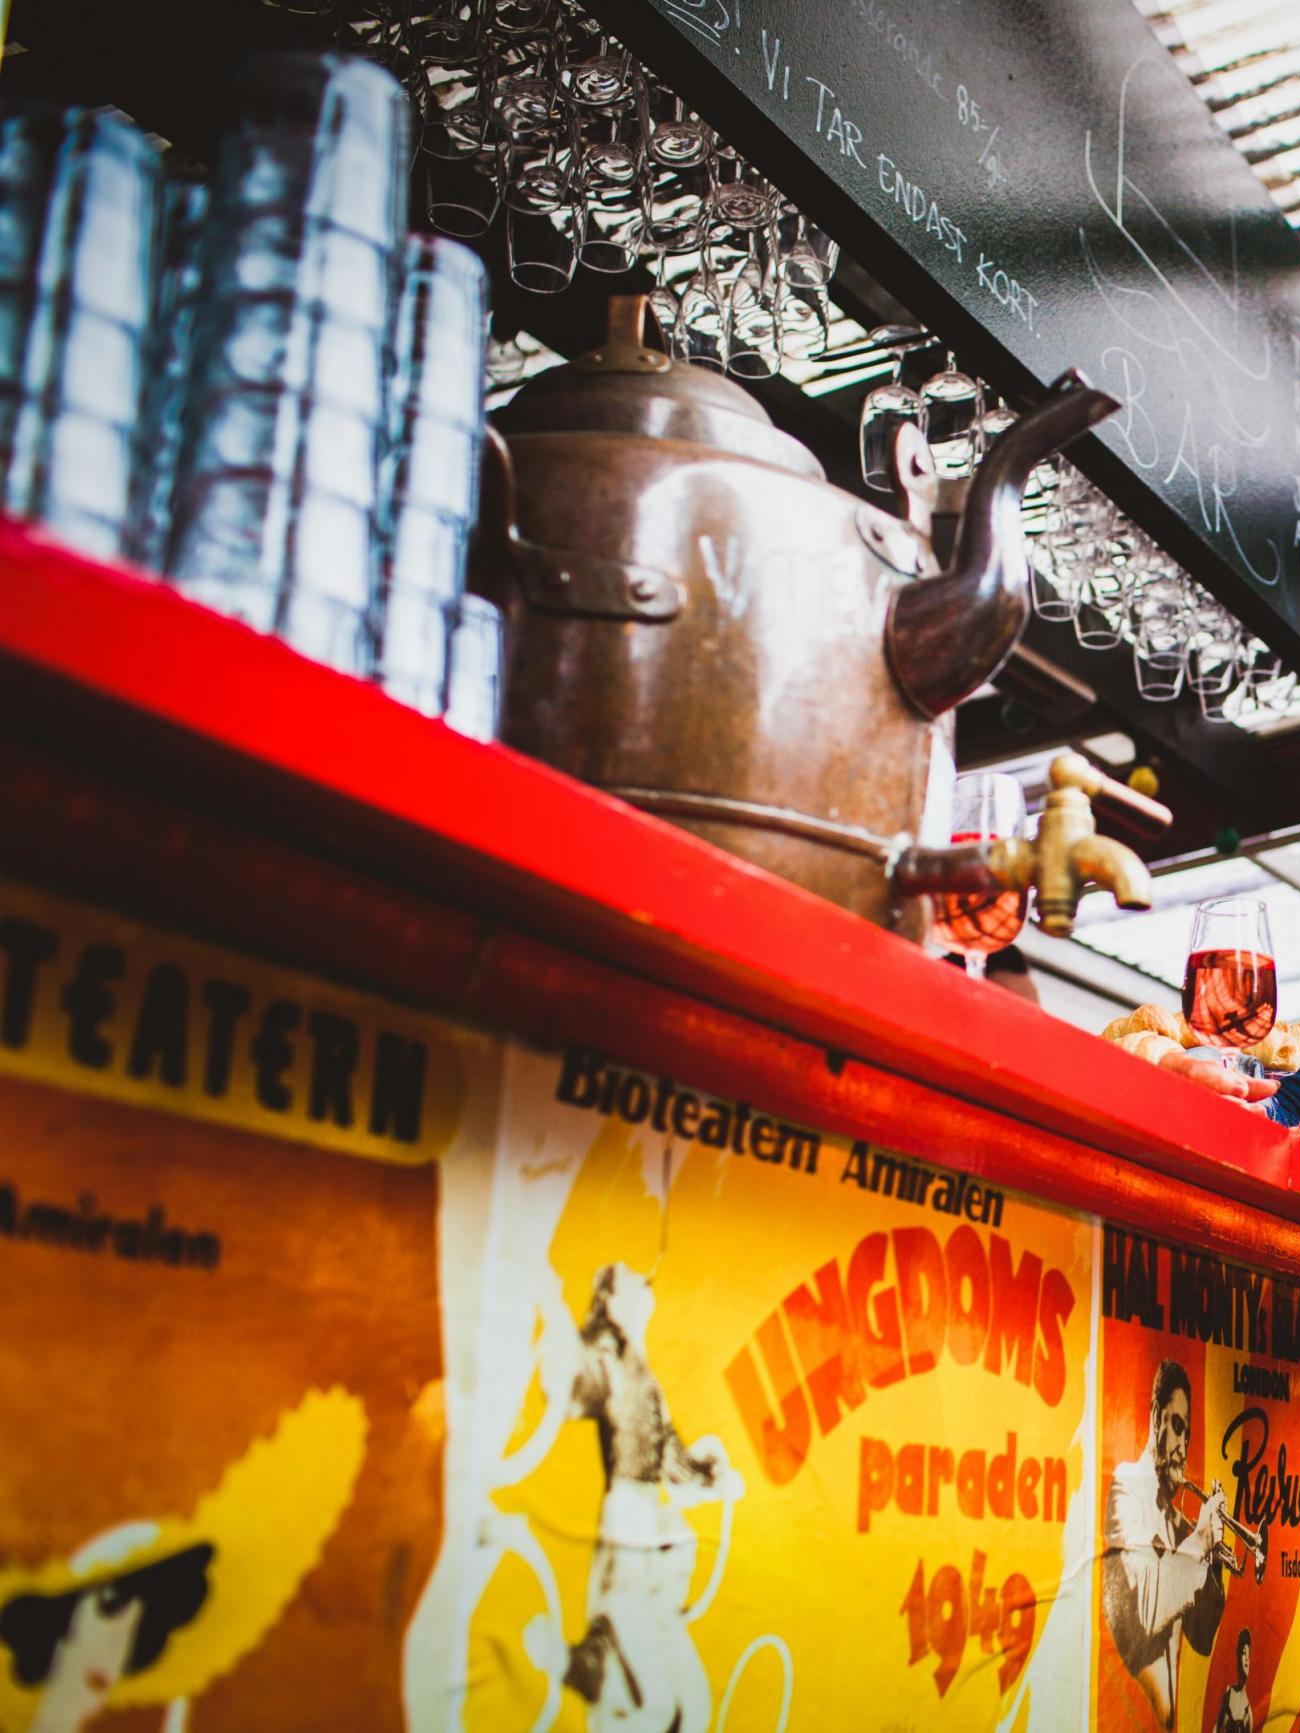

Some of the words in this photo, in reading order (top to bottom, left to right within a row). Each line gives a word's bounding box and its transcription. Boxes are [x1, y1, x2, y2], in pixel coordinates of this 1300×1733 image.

[762, 29, 788, 100] VI
[805, 76, 867, 169] TAR
[877, 153, 967, 263] ENDAST
[840, 1139, 1005, 1228] Amiralen
[1102, 1225, 1164, 1332] HAL
[721, 1223, 1076, 1488] UNGDOMS
[1233, 1360, 1290, 1403] LONDON
[856, 1431, 1068, 1535] paraden
[900, 1549, 1037, 1700] 1949
